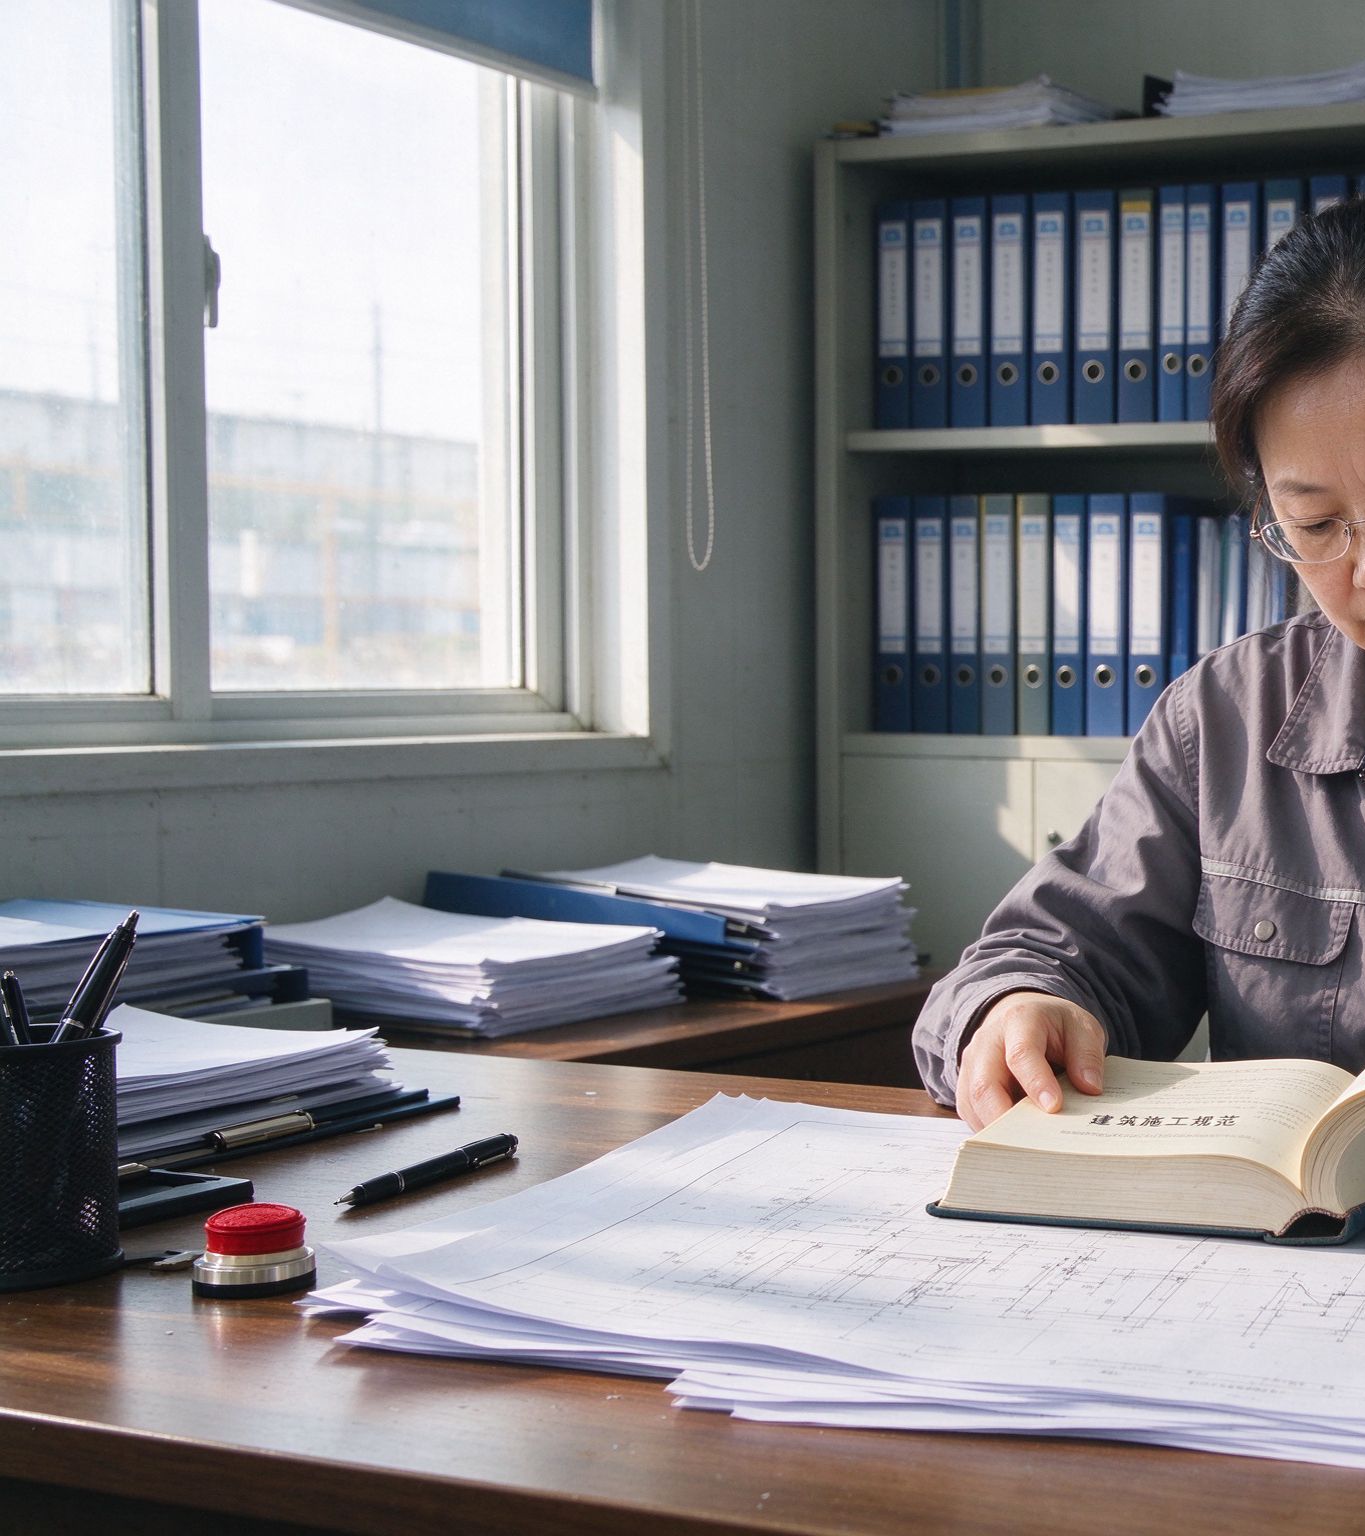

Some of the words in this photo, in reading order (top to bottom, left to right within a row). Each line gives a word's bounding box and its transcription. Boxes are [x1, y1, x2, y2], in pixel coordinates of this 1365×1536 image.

[1088, 1114, 1240, 1127] 建筑施工规范
